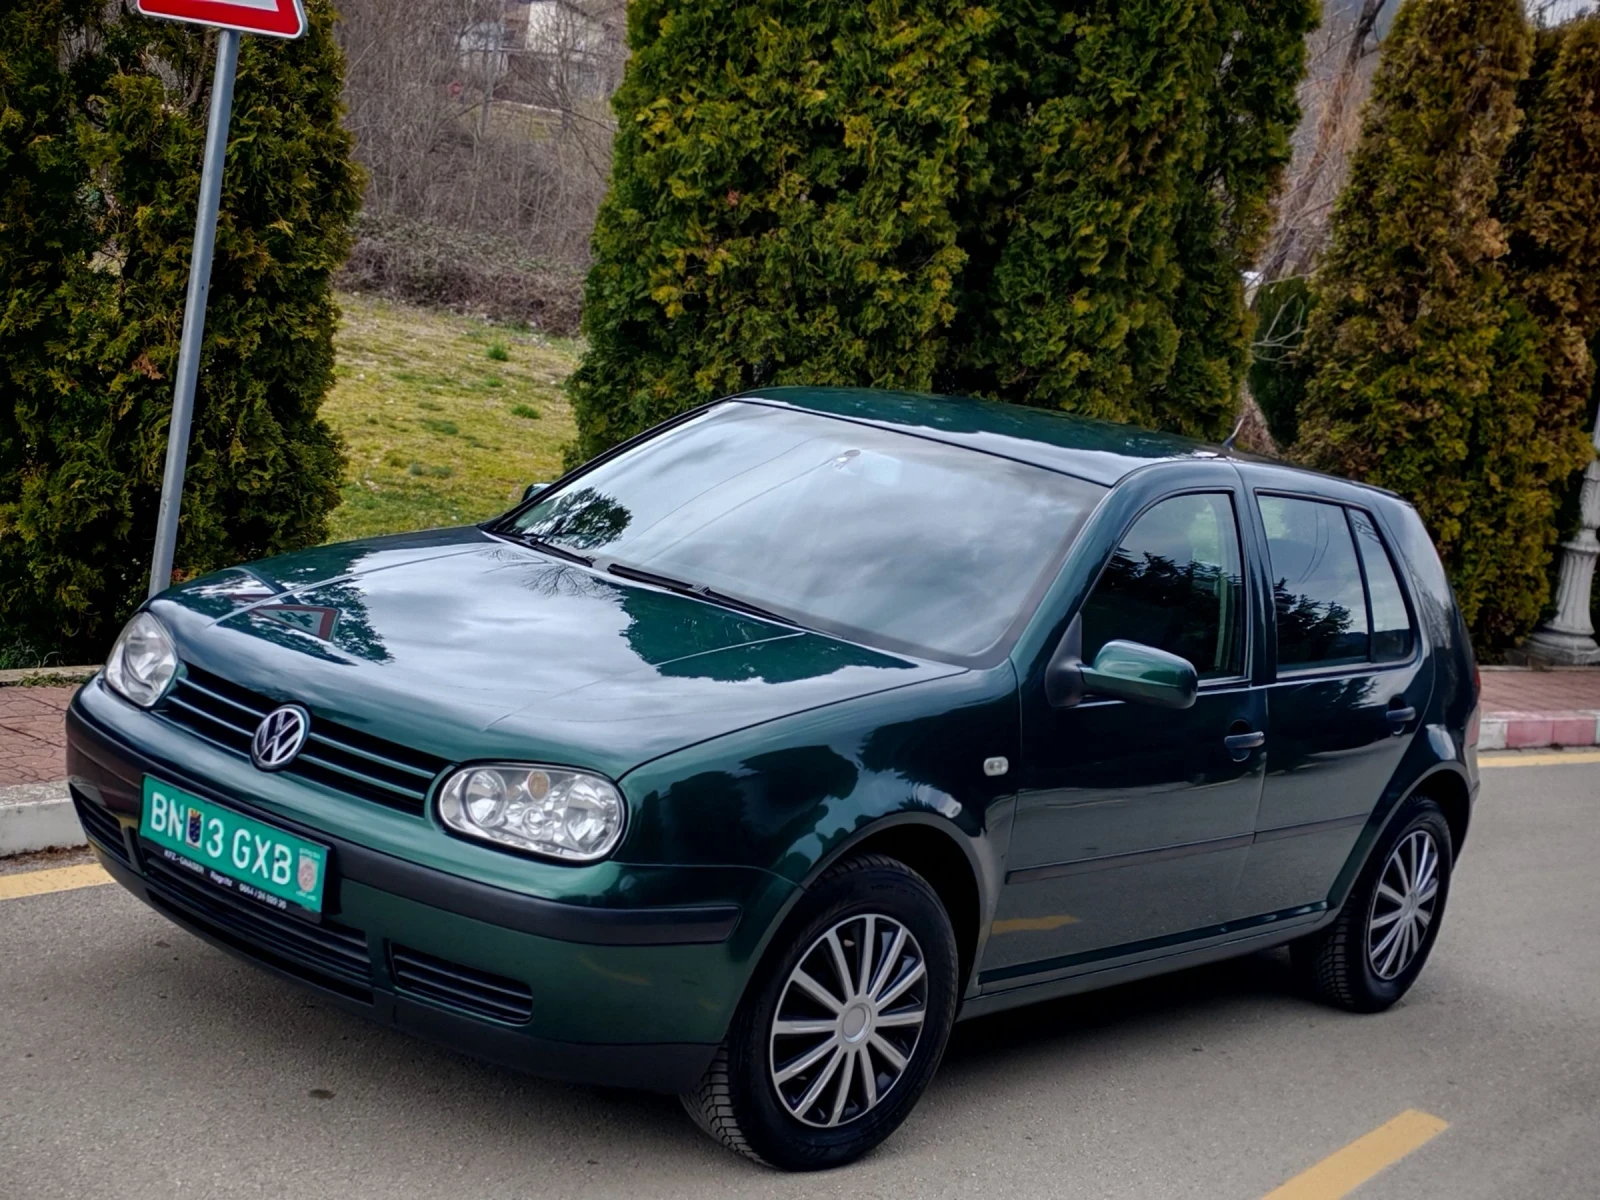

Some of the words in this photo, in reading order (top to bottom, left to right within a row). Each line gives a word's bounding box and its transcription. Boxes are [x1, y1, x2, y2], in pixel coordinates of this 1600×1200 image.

[151, 791, 184, 841] BN
[206, 818, 225, 857] 3
[232, 828, 292, 885] GXB
